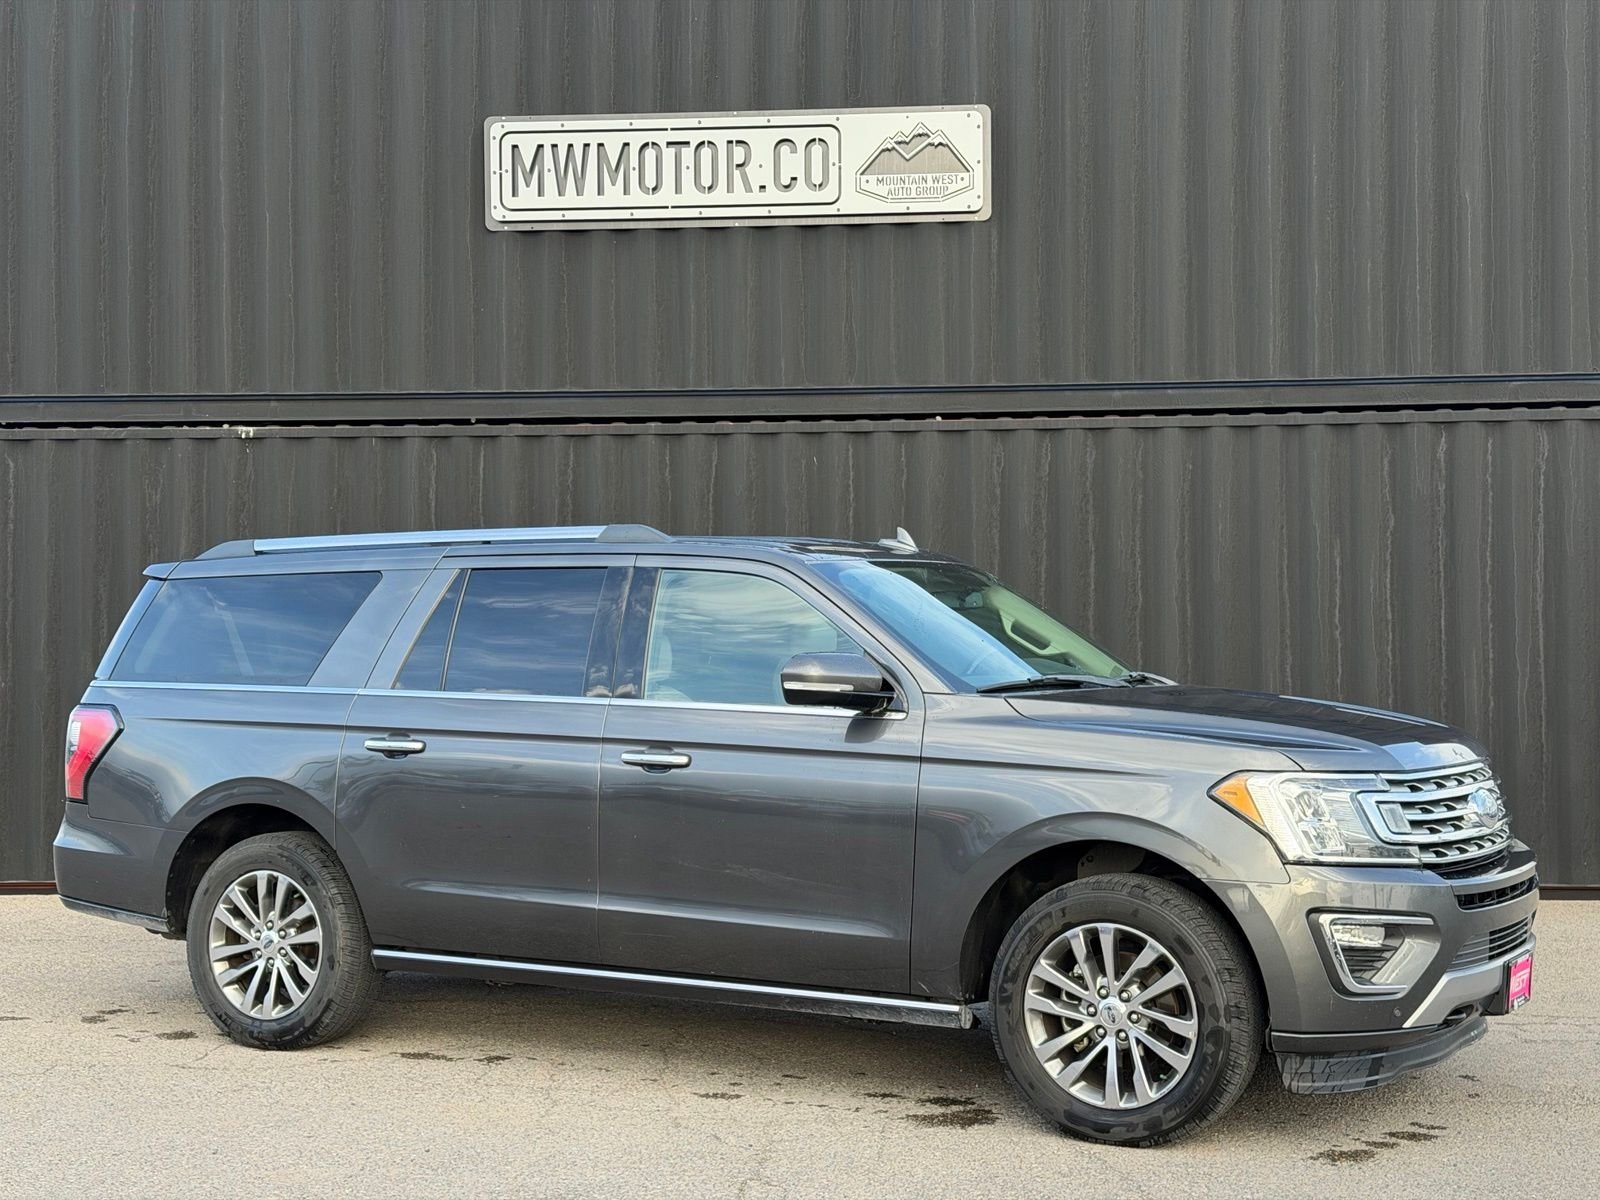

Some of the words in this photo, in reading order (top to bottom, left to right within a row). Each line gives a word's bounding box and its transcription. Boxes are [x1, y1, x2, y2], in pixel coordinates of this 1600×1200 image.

[511, 138, 830, 198] MWMOTOR.CO
[876, 175, 928, 187] MOUNTAIN
[932, 174, 959, 185] WEST
[887, 186, 912, 197] AUTO
[915, 185, 949, 197] GROUP
